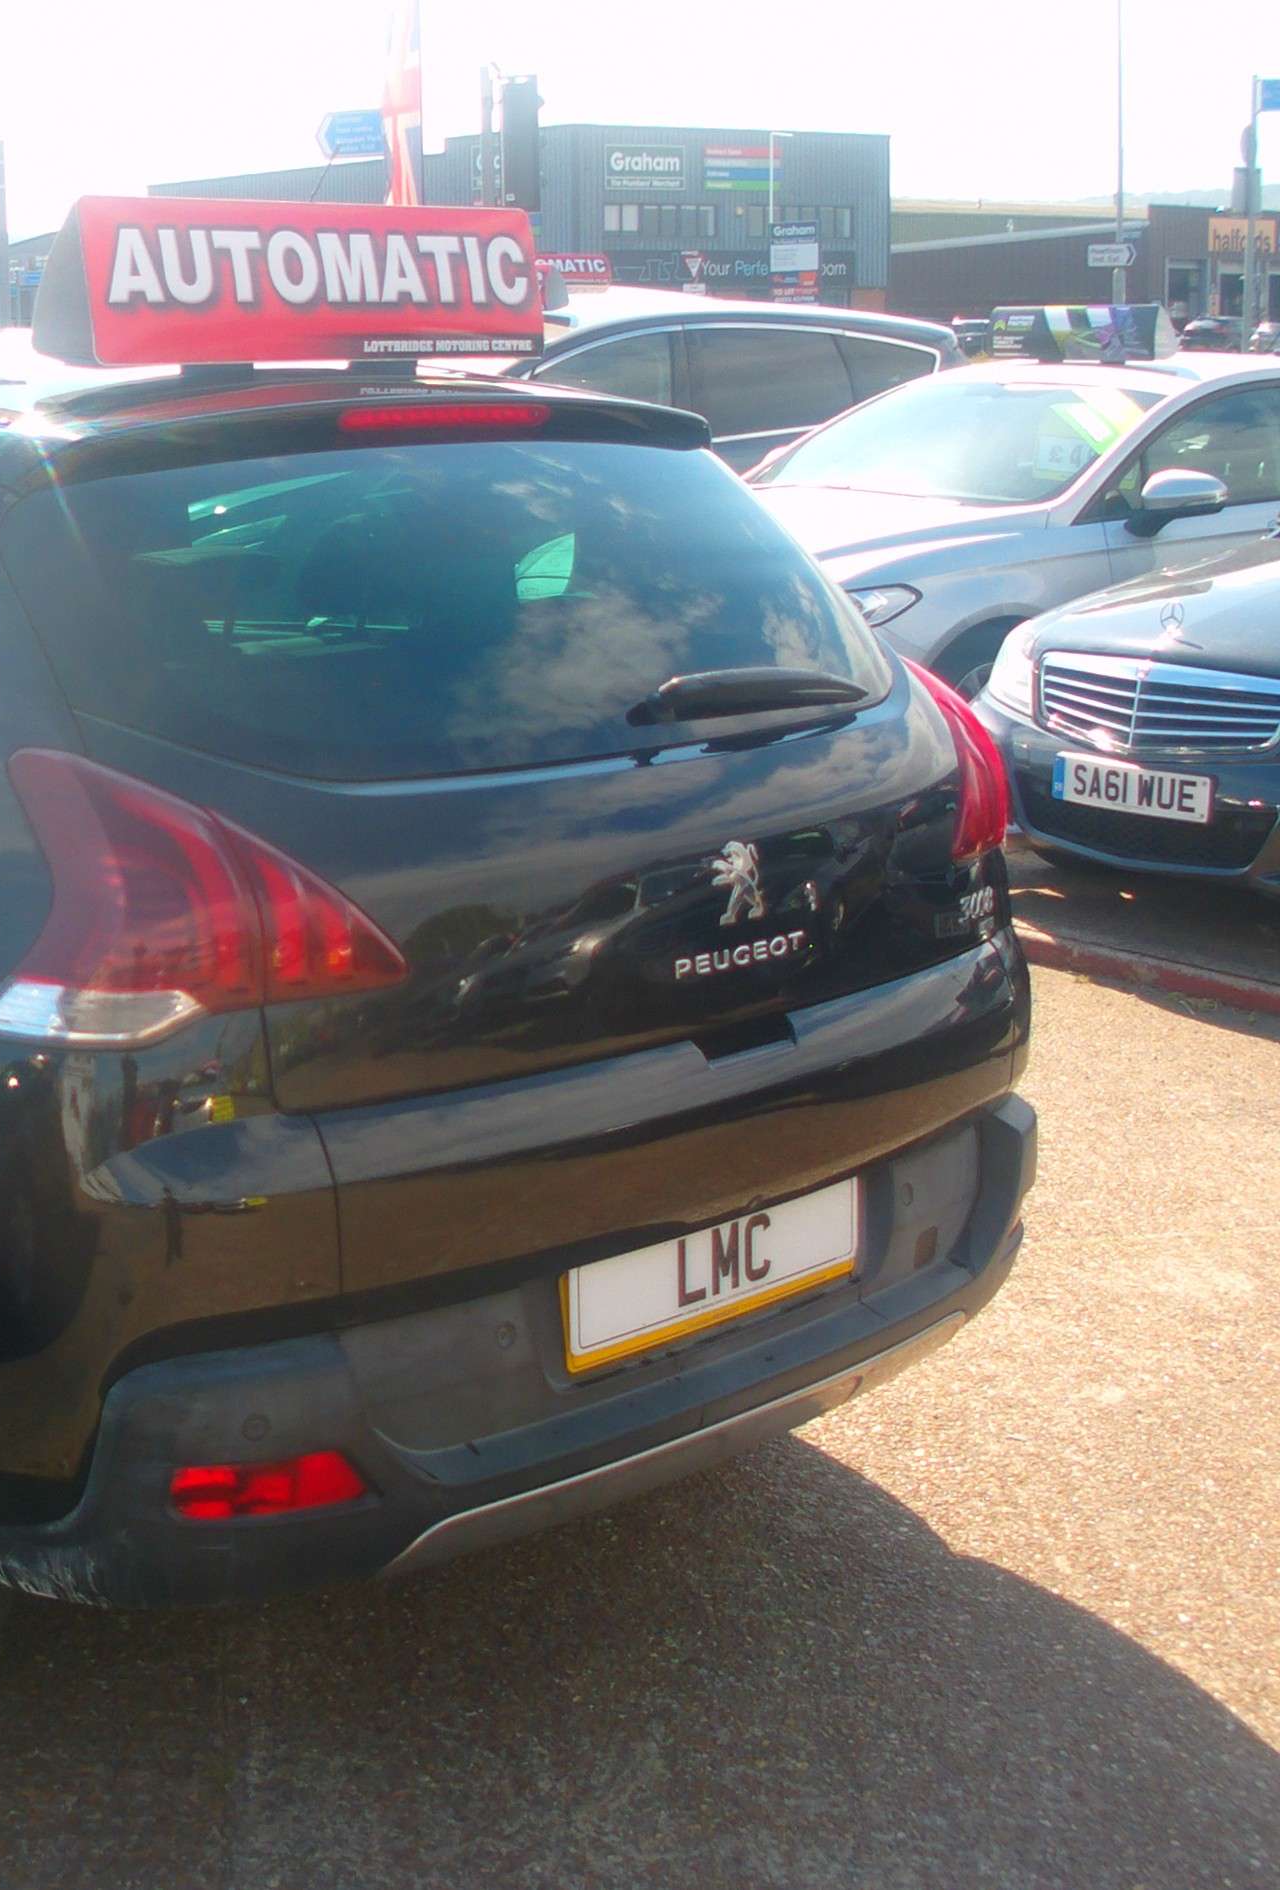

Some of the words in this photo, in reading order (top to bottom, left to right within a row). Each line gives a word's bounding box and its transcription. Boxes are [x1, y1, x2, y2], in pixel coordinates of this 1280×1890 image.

[610, 151, 680, 172] Graham
[773, 224, 816, 237] Graham
[108, 227, 527, 306] AUTOMATIC
[701, 259, 731, 277] Your
[735, 260, 769, 277] Perfe
[435, 340, 490, 352] MOTORING
[491, 339, 533, 352] CENTRE
[1073, 763, 1129, 804] SA61
[1136, 773, 1198, 813] WUE
[674, 930, 804, 980] PEUGEOT
[677, 1213, 771, 1308] LMC
